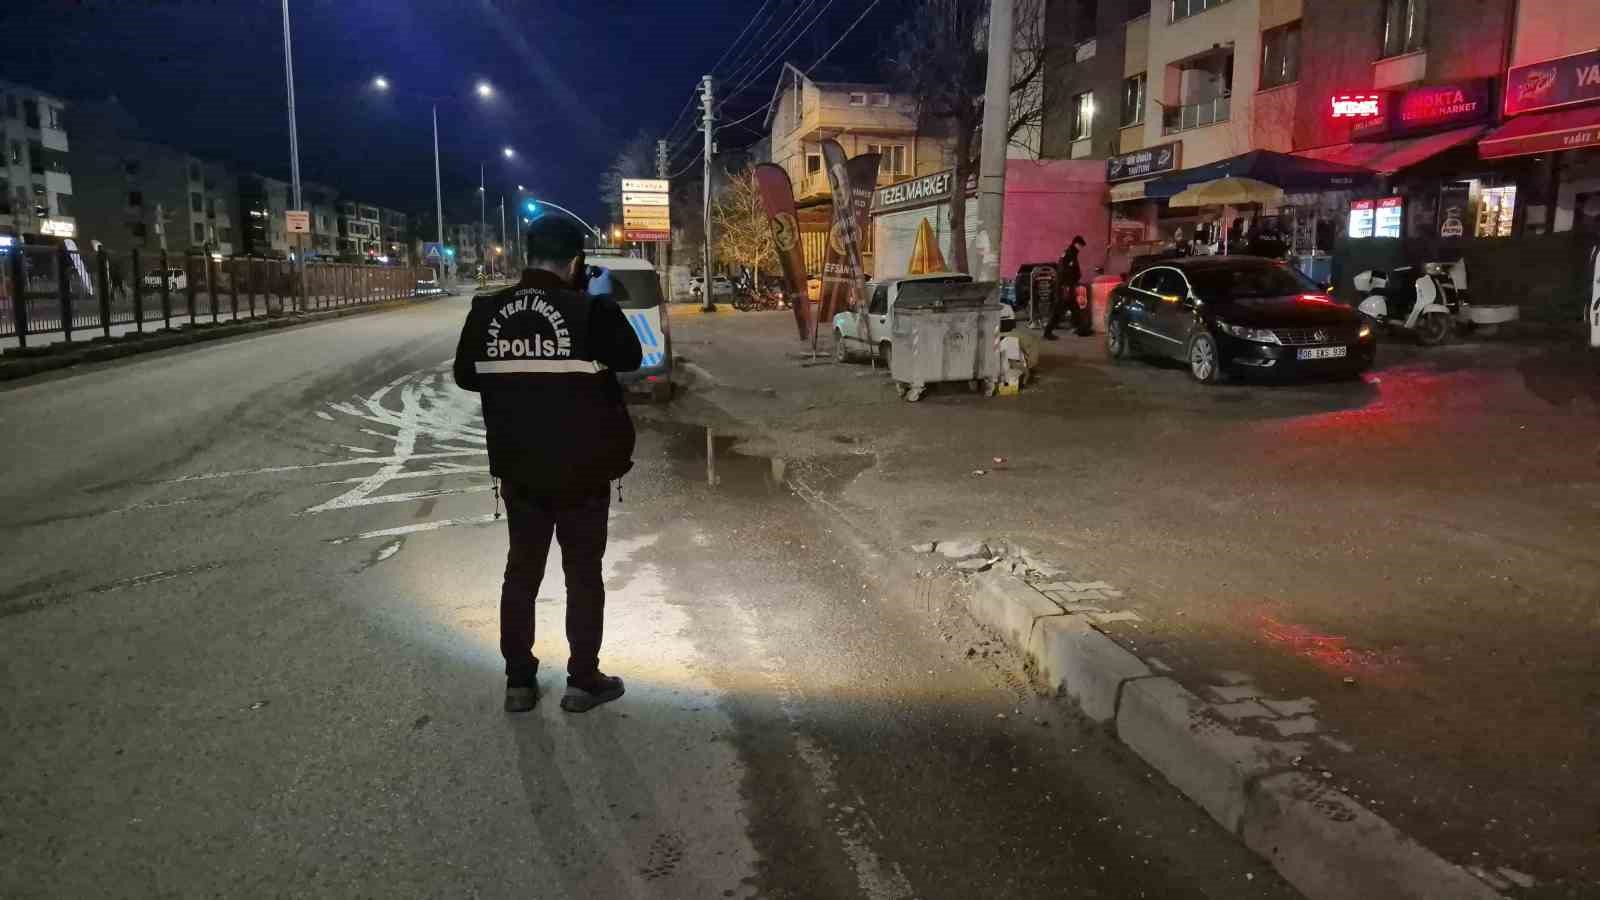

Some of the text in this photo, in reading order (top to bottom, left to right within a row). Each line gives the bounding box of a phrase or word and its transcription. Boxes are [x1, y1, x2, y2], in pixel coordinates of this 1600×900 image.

[1439, 102, 1477, 117] MARKET
[880, 187, 905, 206] TEZEL
[906, 174, 951, 200] MARKET
[825, 262, 850, 275] EFSAN
[486, 317, 501, 357] OLAY
